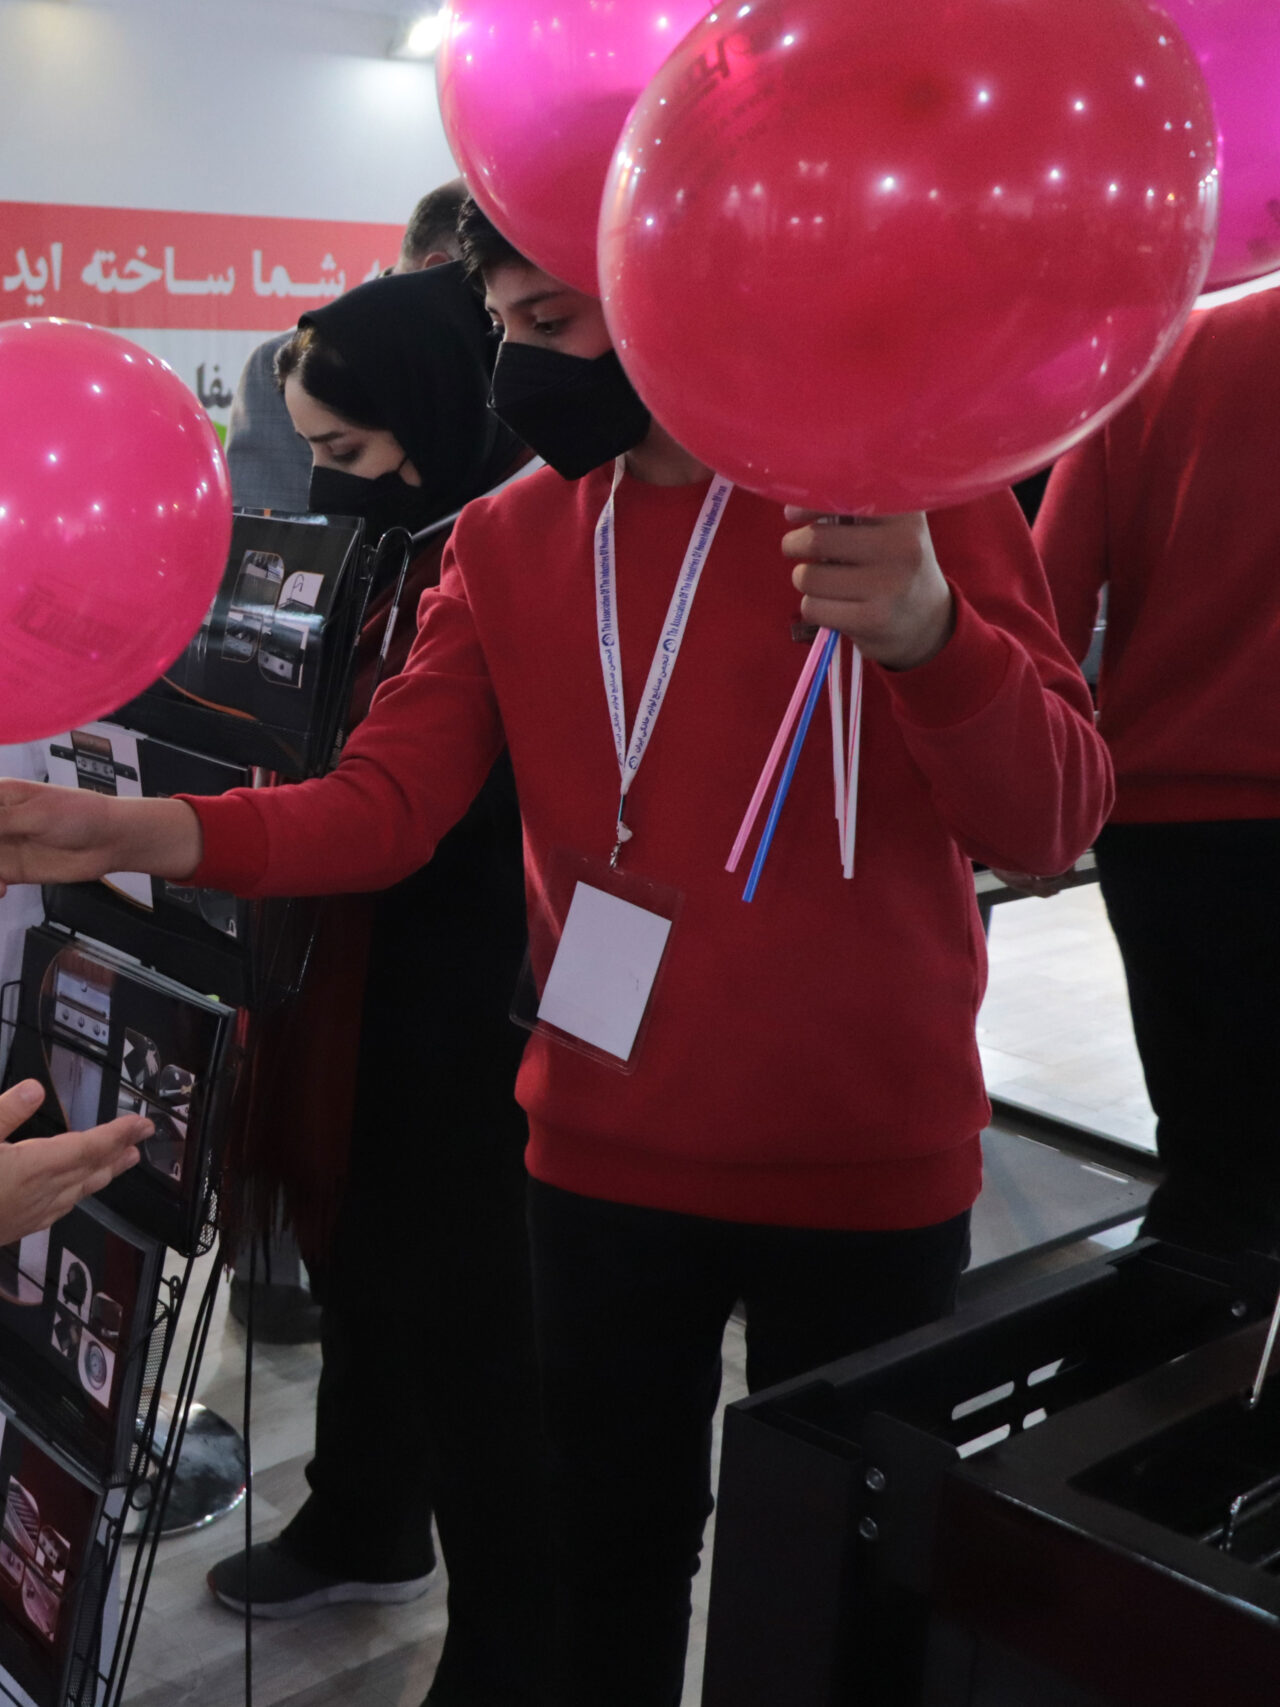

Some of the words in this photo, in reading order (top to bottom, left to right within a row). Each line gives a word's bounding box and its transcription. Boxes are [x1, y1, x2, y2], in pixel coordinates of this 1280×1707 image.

[80, 241, 236, 296] ساخته
[252, 247, 345, 298] شما
[680, 582, 692, 591] The
[670, 598, 687, 627] Association
[601, 622, 611, 633] The
[665, 627, 679, 637] The
